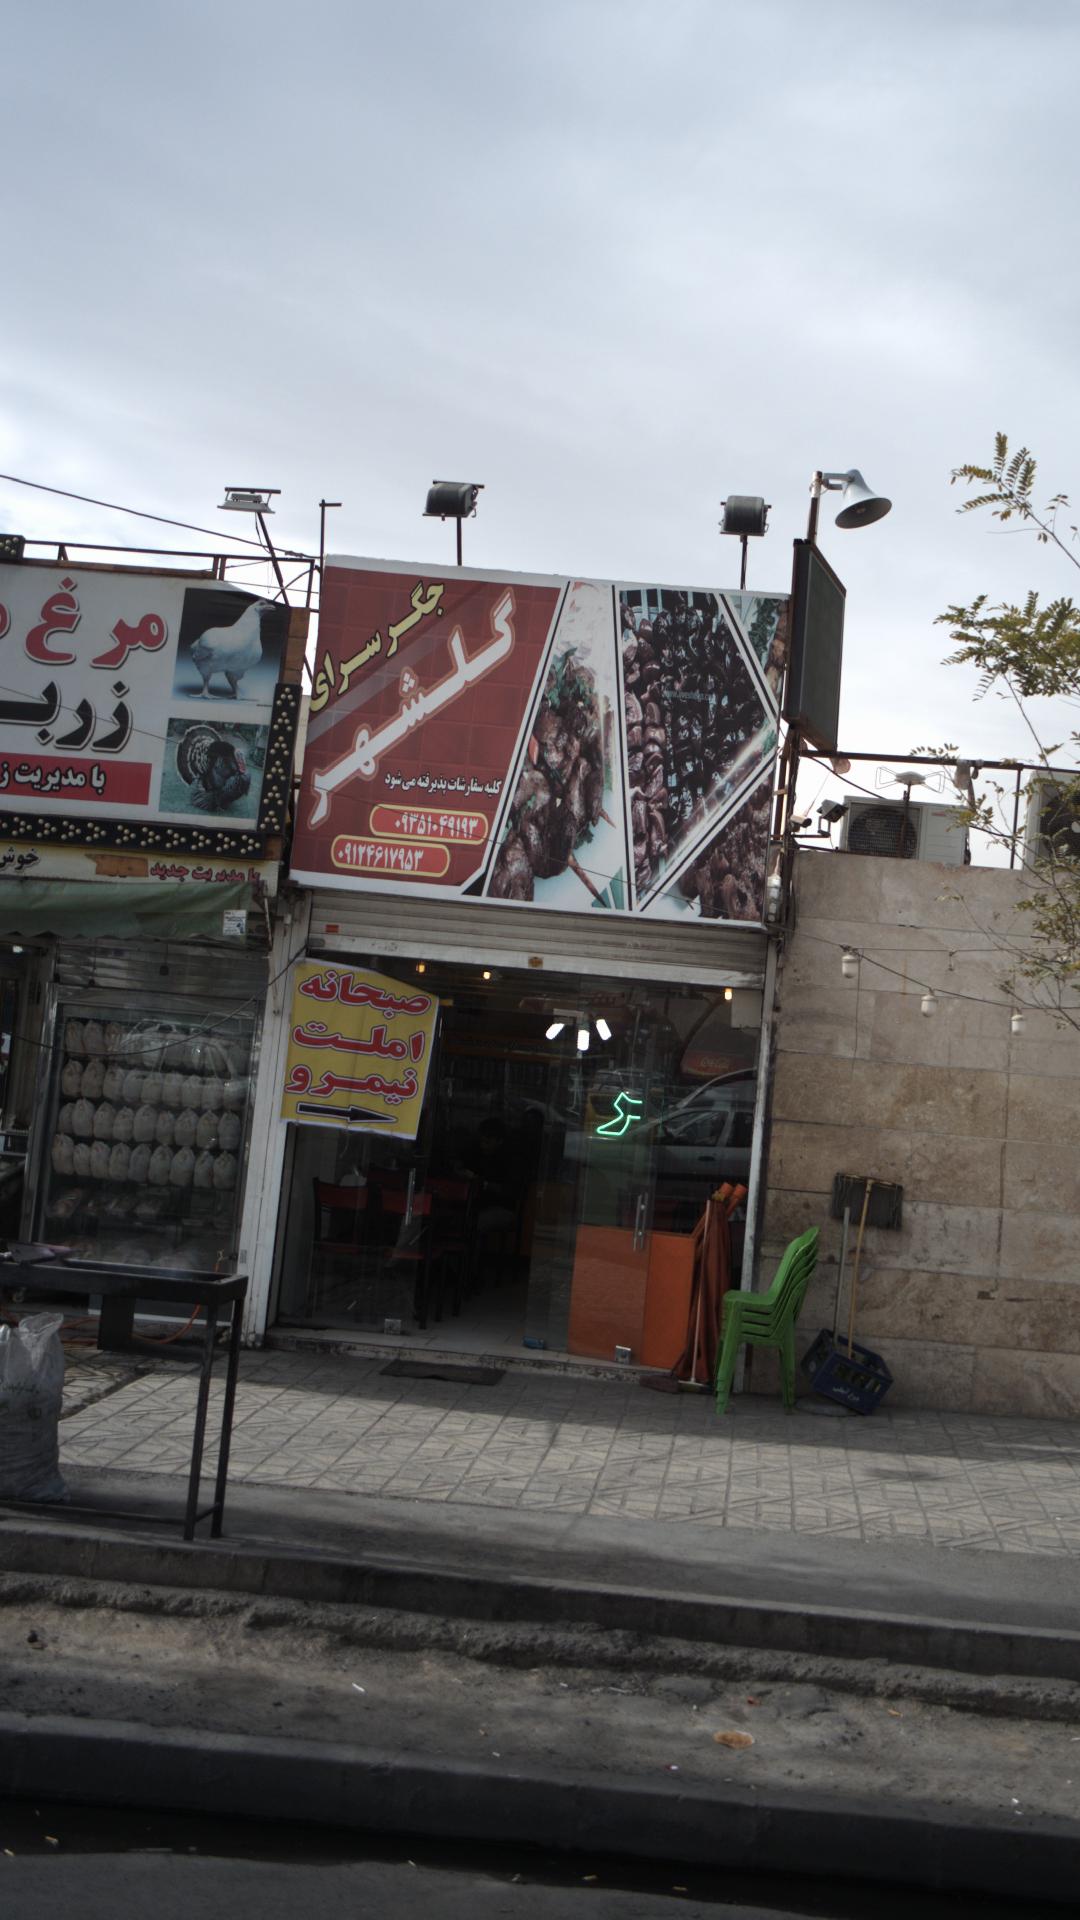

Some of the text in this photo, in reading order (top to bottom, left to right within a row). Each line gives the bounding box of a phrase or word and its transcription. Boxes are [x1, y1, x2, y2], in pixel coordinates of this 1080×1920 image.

[25, 576, 168, 669] مرغ
[309, 580, 444, 712] جگر سرای
[310, 591, 514, 825] گلشهر
[14, 763, 86, 791] مدیریت
[91, 764, 106, 794] با
[416, 772, 447, 794] پذیرفته
[447, 776, 483, 796] سفارشات
[484, 779, 502, 797] کلیه
[150, 862, 189, 882] جدید
[300, 970, 432, 1018] صبحانه
[293, 1022, 425, 1062] املت
[285, 1065, 418, 1104] نیمرو
